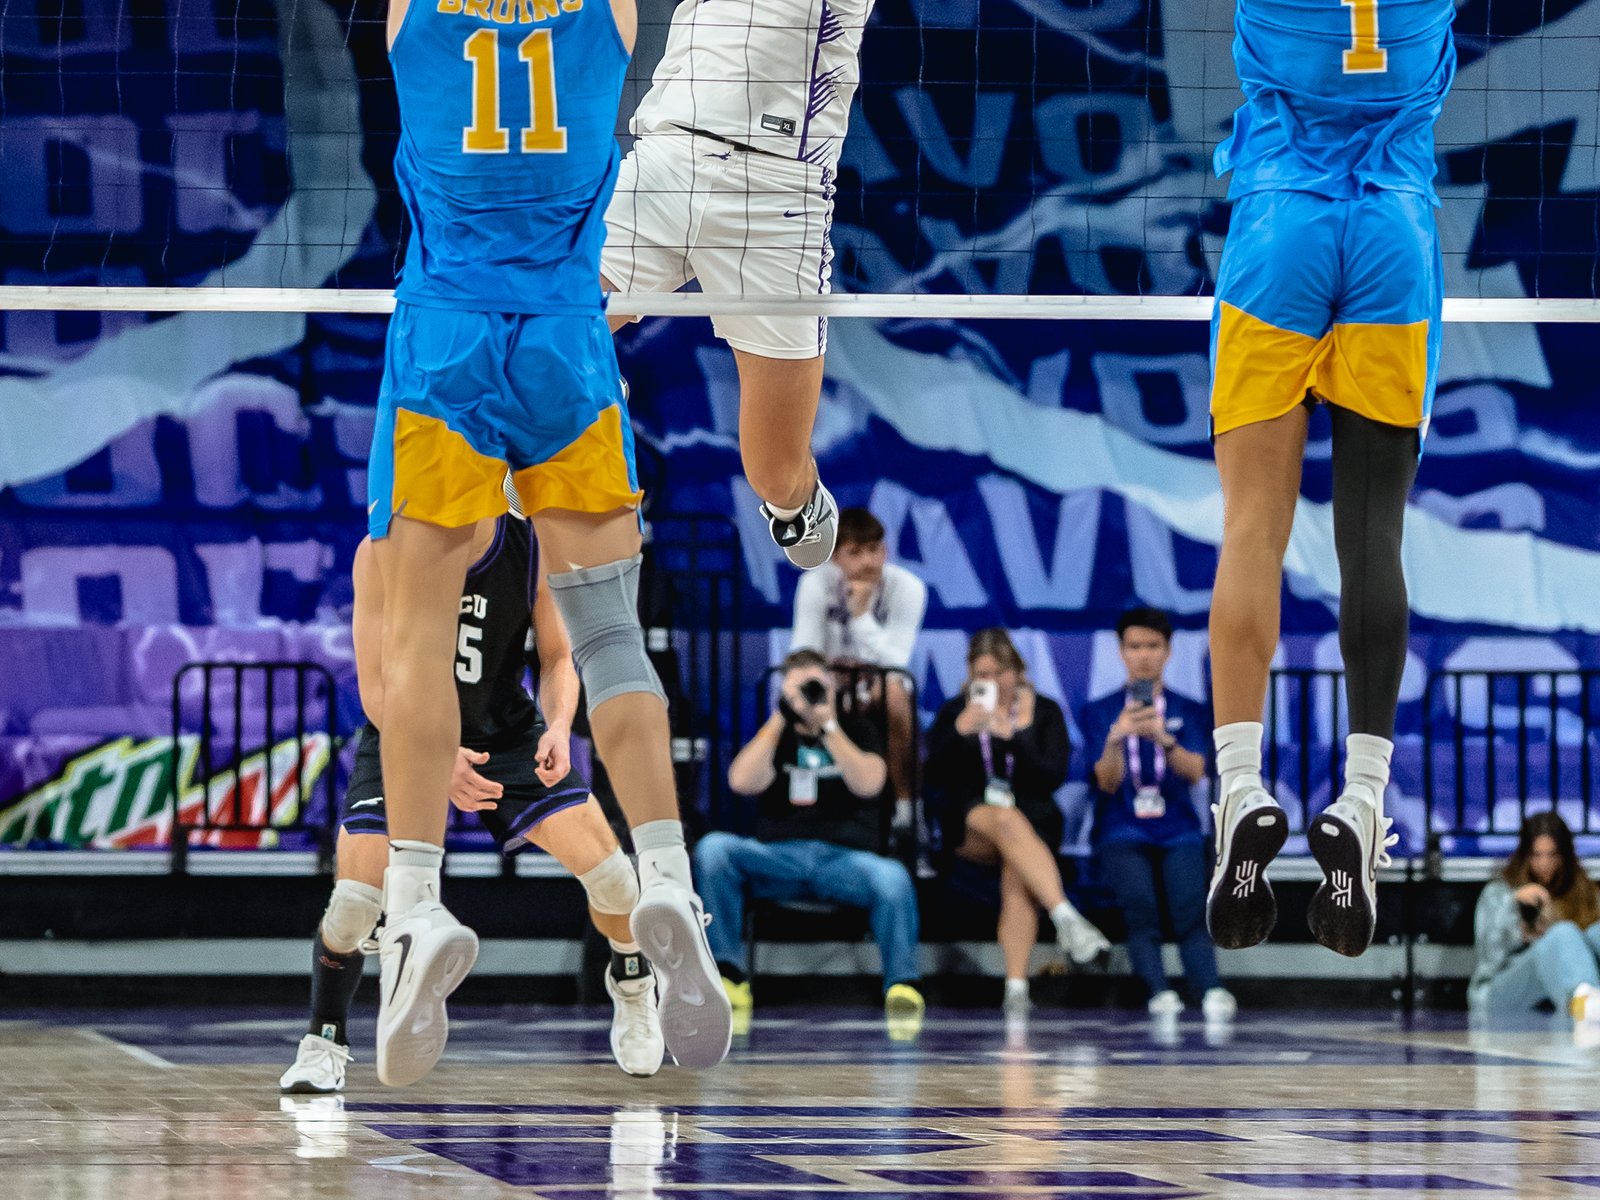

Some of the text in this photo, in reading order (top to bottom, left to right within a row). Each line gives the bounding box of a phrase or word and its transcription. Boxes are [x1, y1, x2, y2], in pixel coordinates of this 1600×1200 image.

[462, 28, 568, 154] 11
[460, 593, 489, 620] CU
[455, 622, 483, 685] 5
